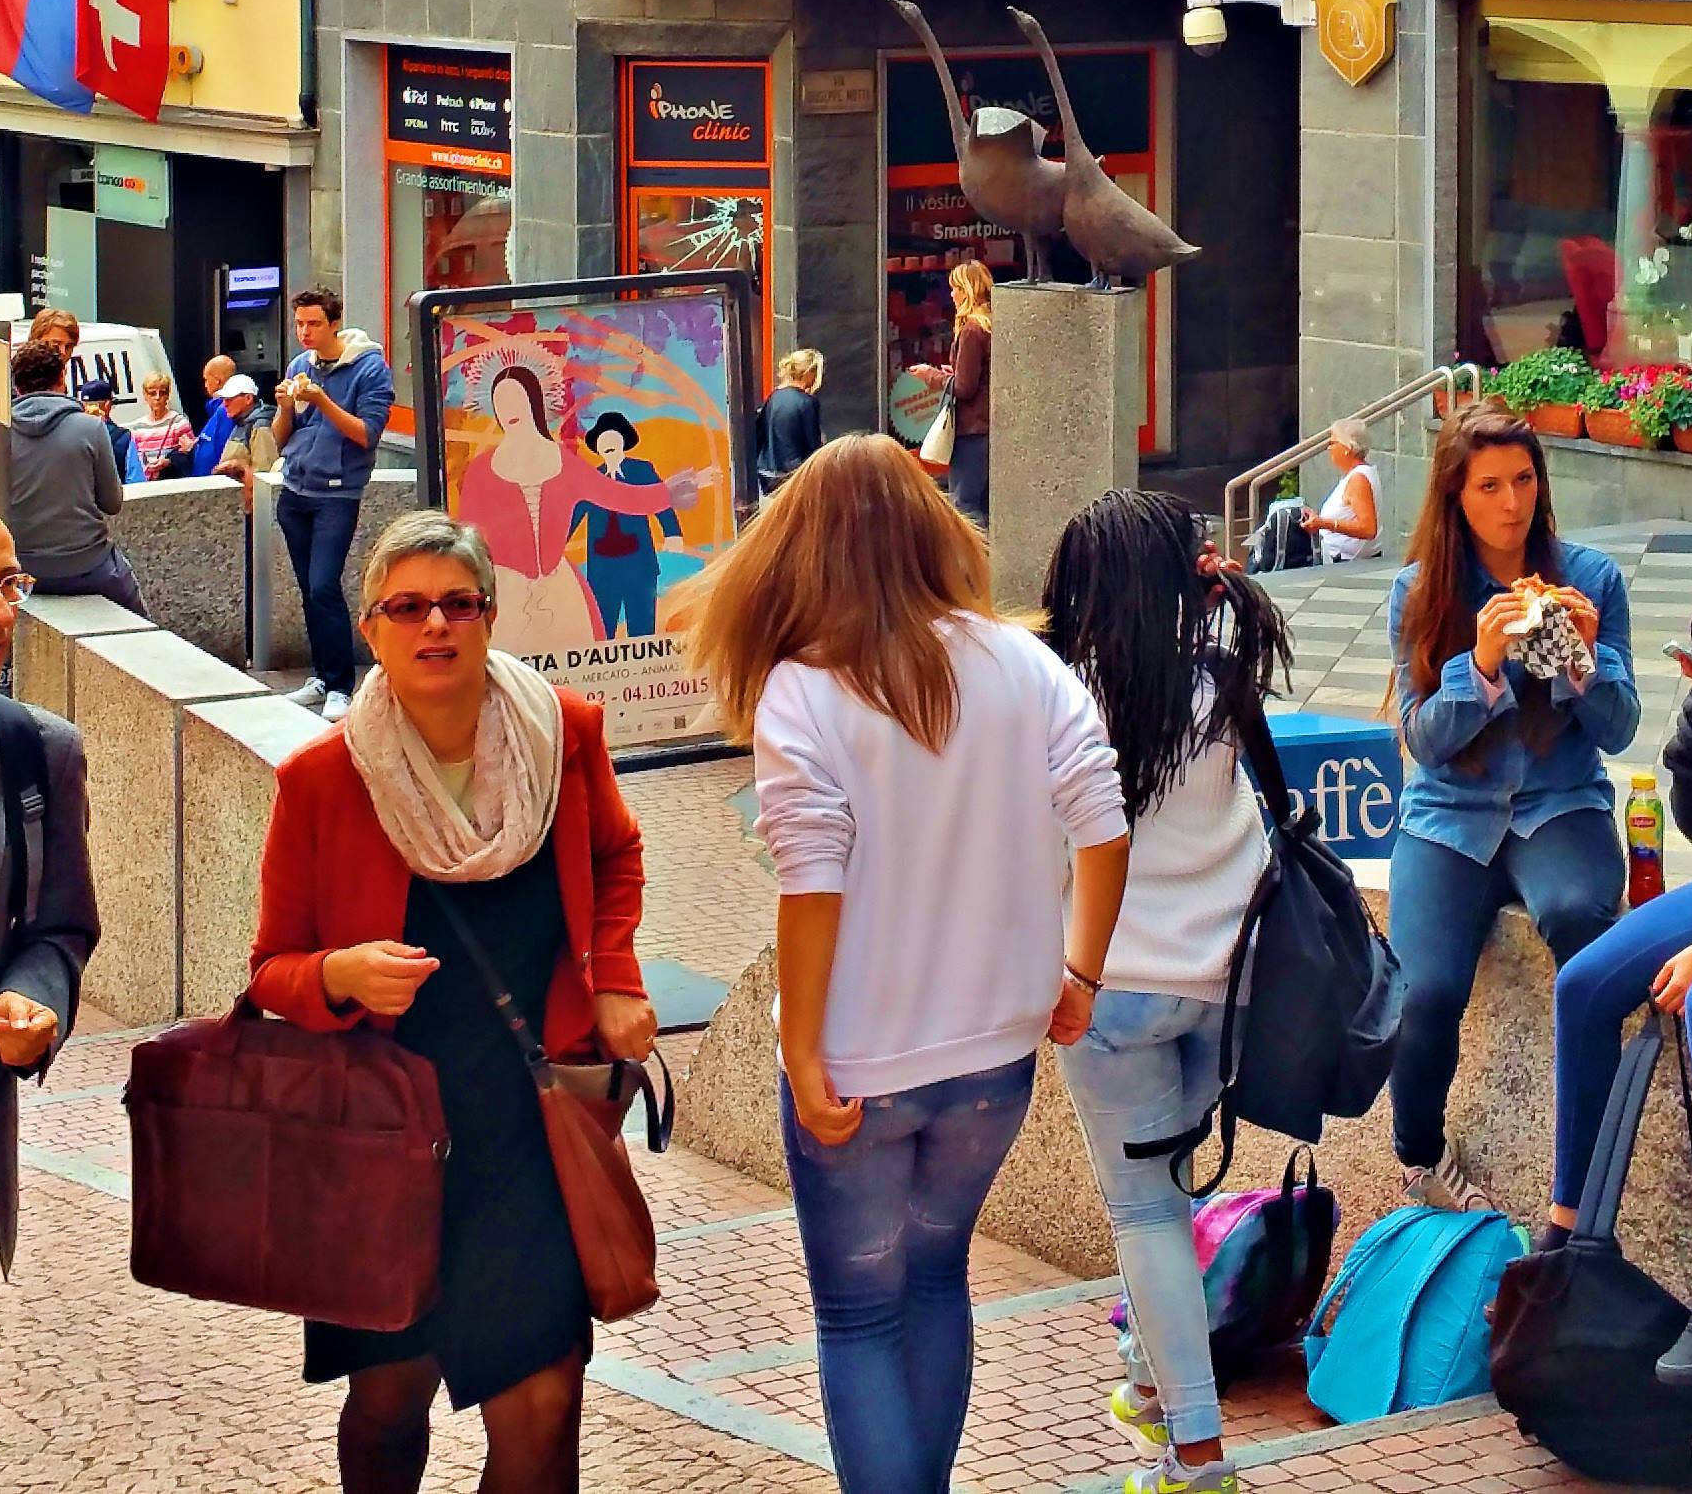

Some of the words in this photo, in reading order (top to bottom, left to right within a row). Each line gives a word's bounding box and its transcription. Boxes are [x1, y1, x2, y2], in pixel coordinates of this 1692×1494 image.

[692, 120, 751, 142] clinic
[395, 168, 429, 188] Grande
[918, 193, 967, 211] vestro
[520, 654, 559, 673] STA
[566, 638, 687, 669] D'AUTUNN
[582, 668, 631, 684] MERCATO
[622, 676, 710, 704] 04.10.2015
[1255, 757, 1395, 842] affè
